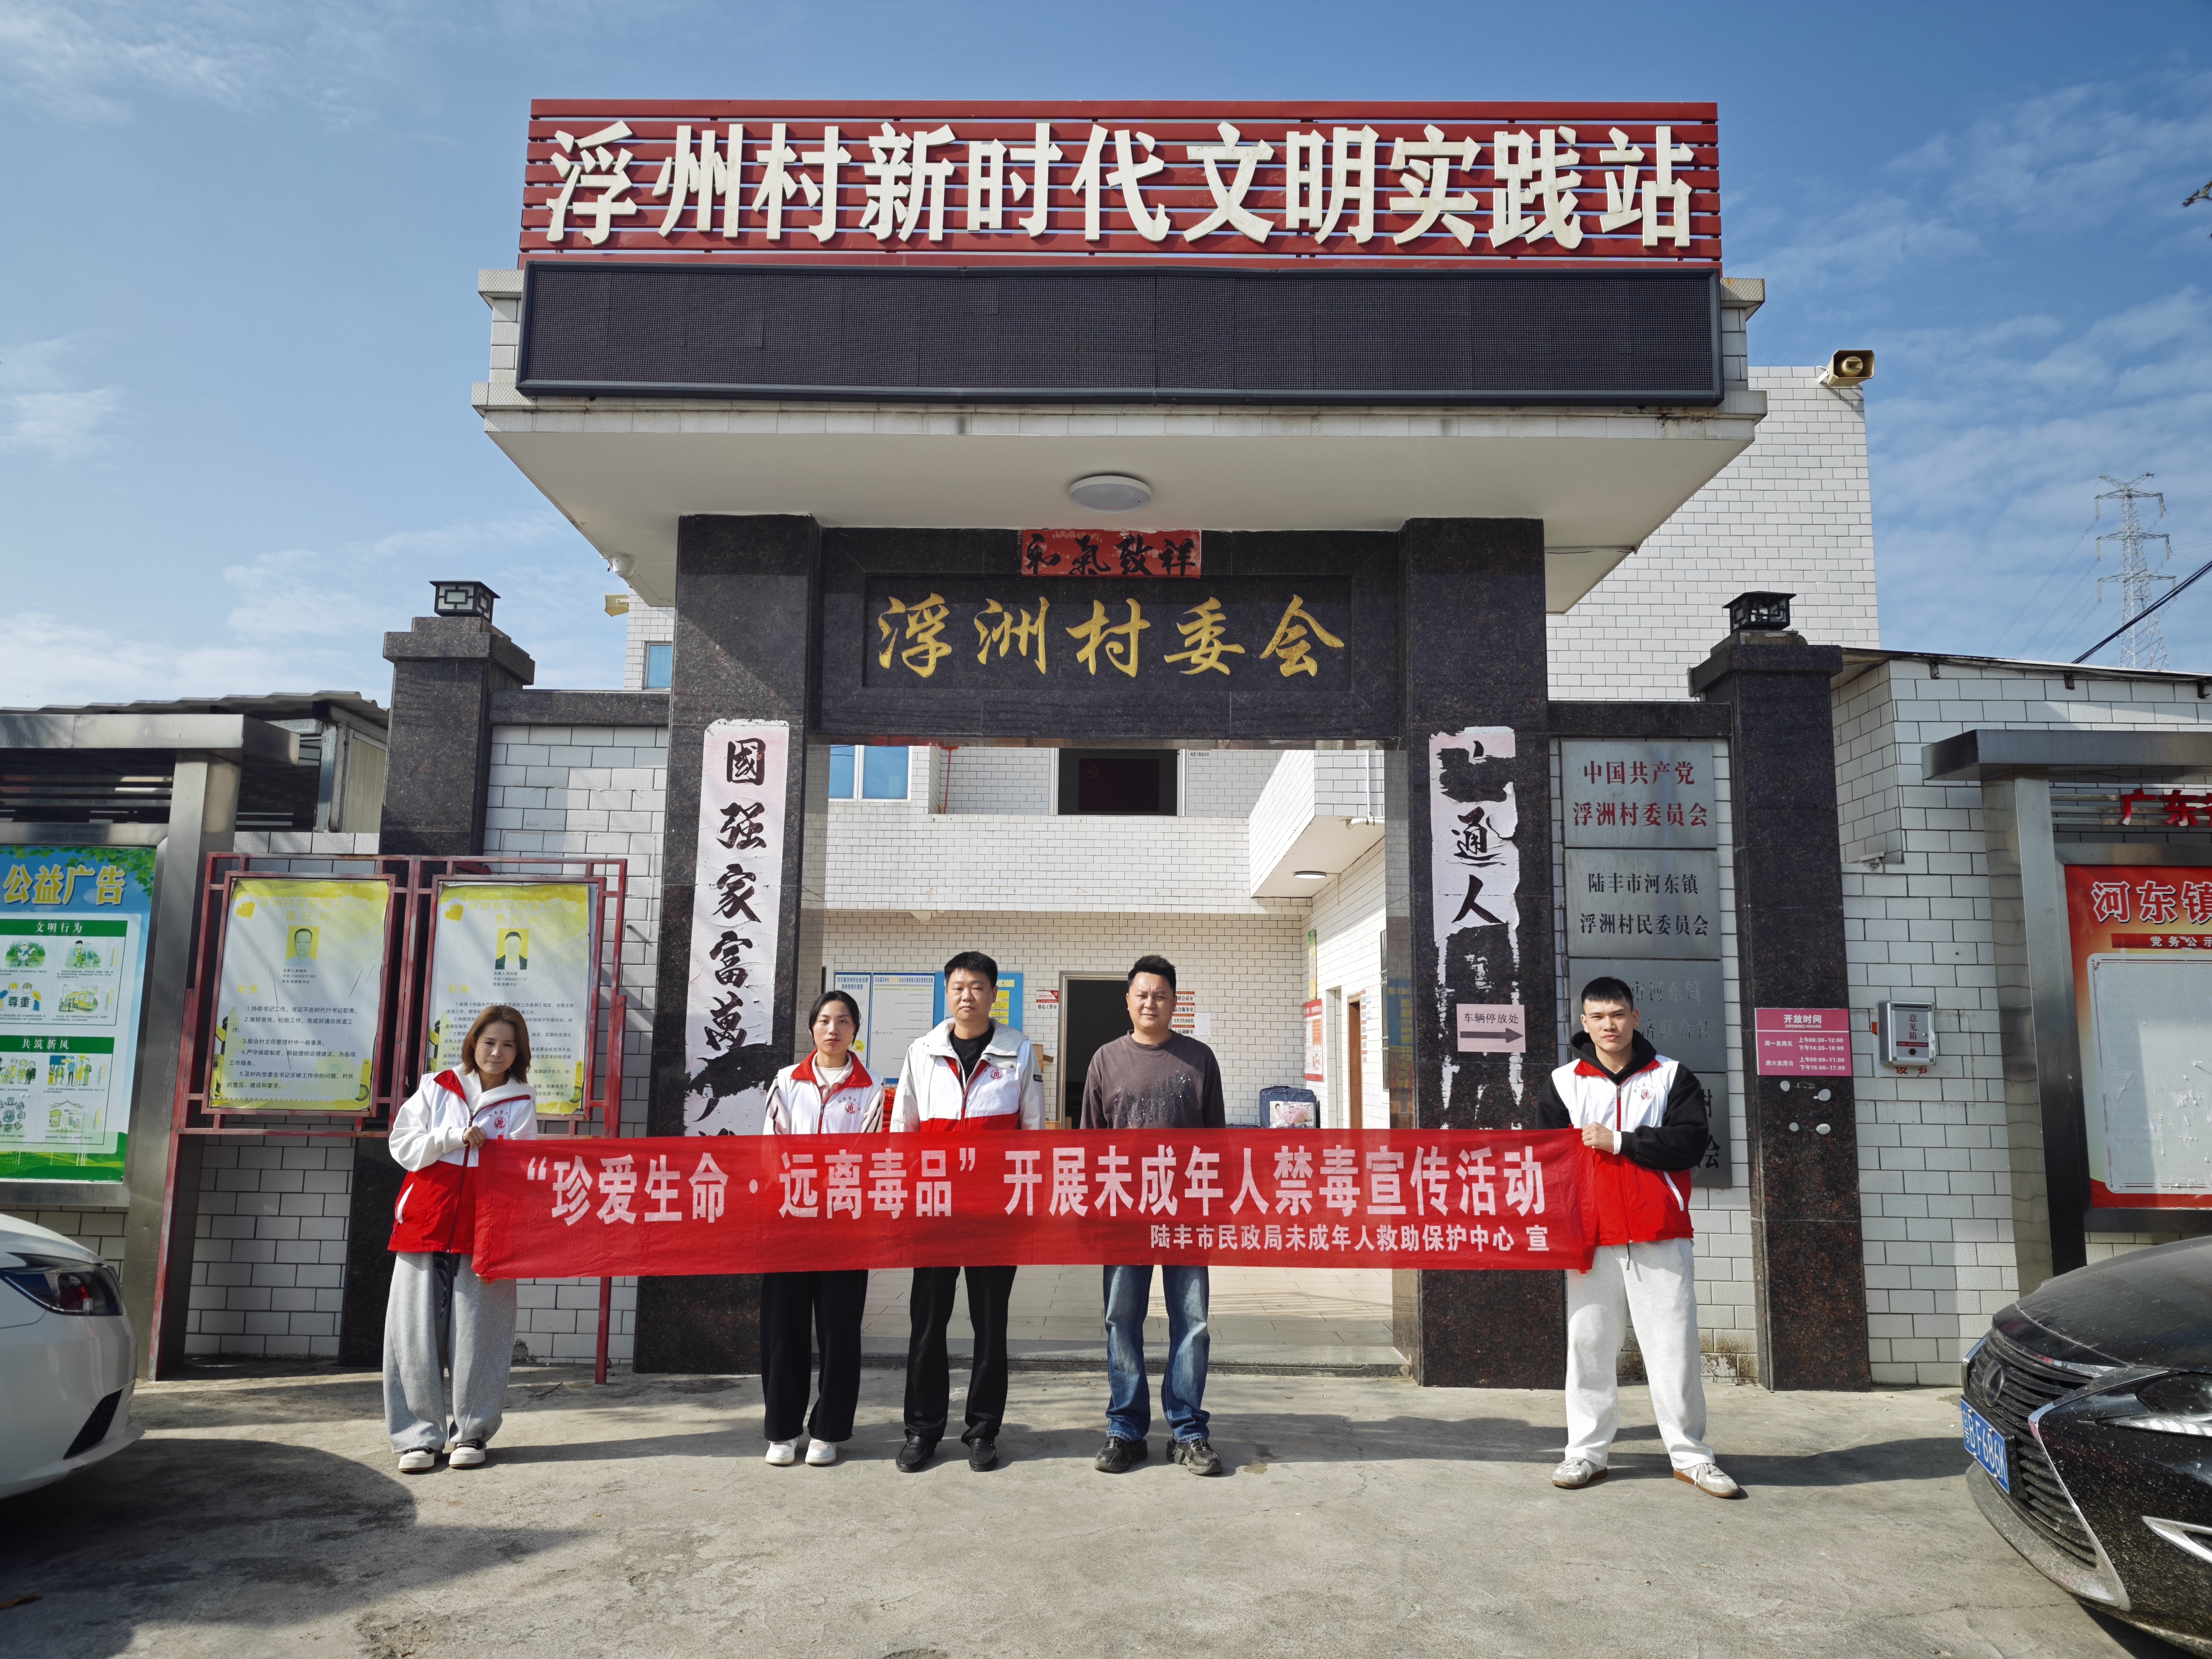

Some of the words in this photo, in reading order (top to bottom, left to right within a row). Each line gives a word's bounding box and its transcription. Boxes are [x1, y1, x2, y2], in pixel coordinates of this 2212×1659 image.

[546, 119, 1694, 249] 浮州村新时代文明实践站
[878, 592, 1344, 678] 浮洲村委会
[1584, 760, 1695, 785] 中国共产党
[1573, 802, 1708, 827] 浮洲村委员会
[1451, 740, 1506, 924] 通人
[3, 864, 125, 905] 公益广告
[1588, 873, 1698, 894] 陆丰市河东镇
[259, 896, 369, 911] 浮洲村党群服务中心
[467, 899, 578, 913] 浮洲村党群服务中心
[2091, 880, 2212, 924] 河东镇
[286, 911, 329, 922] 责任岗
[494, 913, 539, 925] 责任岗
[1580, 913, 1708, 936] 浮洲村民委员会
[35, 922, 83, 933] 文明行为
[237, 985, 258, 994] 职责
[449, 985, 469, 994] 职责
[8, 996, 30, 1008] 尊重
[1464, 1013, 1519, 1023] 车辆停放处
[1784, 1015, 1822, 1024] 开放时间
[1908, 1014, 1917, 1040] 意见箱
[22, 1038, 69, 1050] 共筑新风
[1004, 1144, 1546, 1217] 开展未成年人禁毒宣传活动
[1150, 1224, 1514, 1252] 陆丰市民政局未成年人救助保护中心
